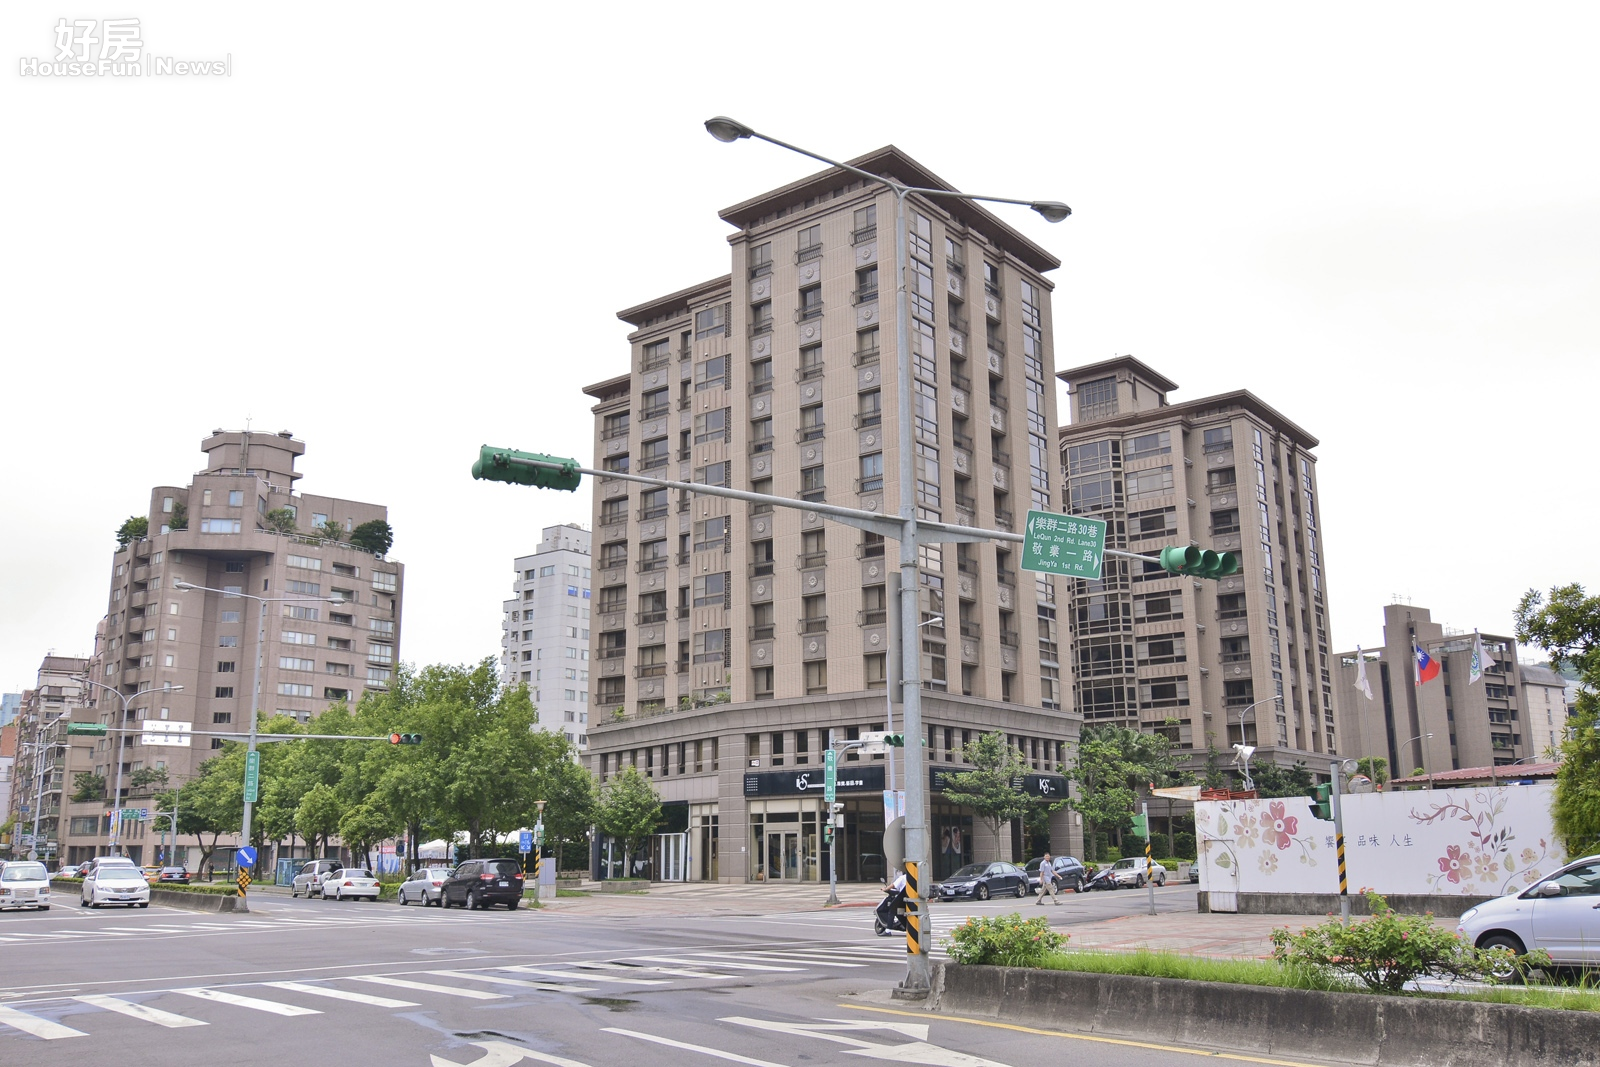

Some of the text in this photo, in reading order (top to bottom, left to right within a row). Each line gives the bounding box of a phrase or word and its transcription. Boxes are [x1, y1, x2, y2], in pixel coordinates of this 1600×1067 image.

[1035, 516, 1098, 538] 樂群二路30巷
[1033, 532, 1052, 541] LeQun
[1053, 535, 1065, 543] 2nd
[1066, 537, 1076, 545] Rd.
[1032, 541, 1093, 562] 敬業一路
[1062, 562, 1071, 570] 1st
[1074, 563, 1084, 571] Rd.
[1358, 834, 1380, 847] 品味
[1390, 833, 1414, 847] 人生
